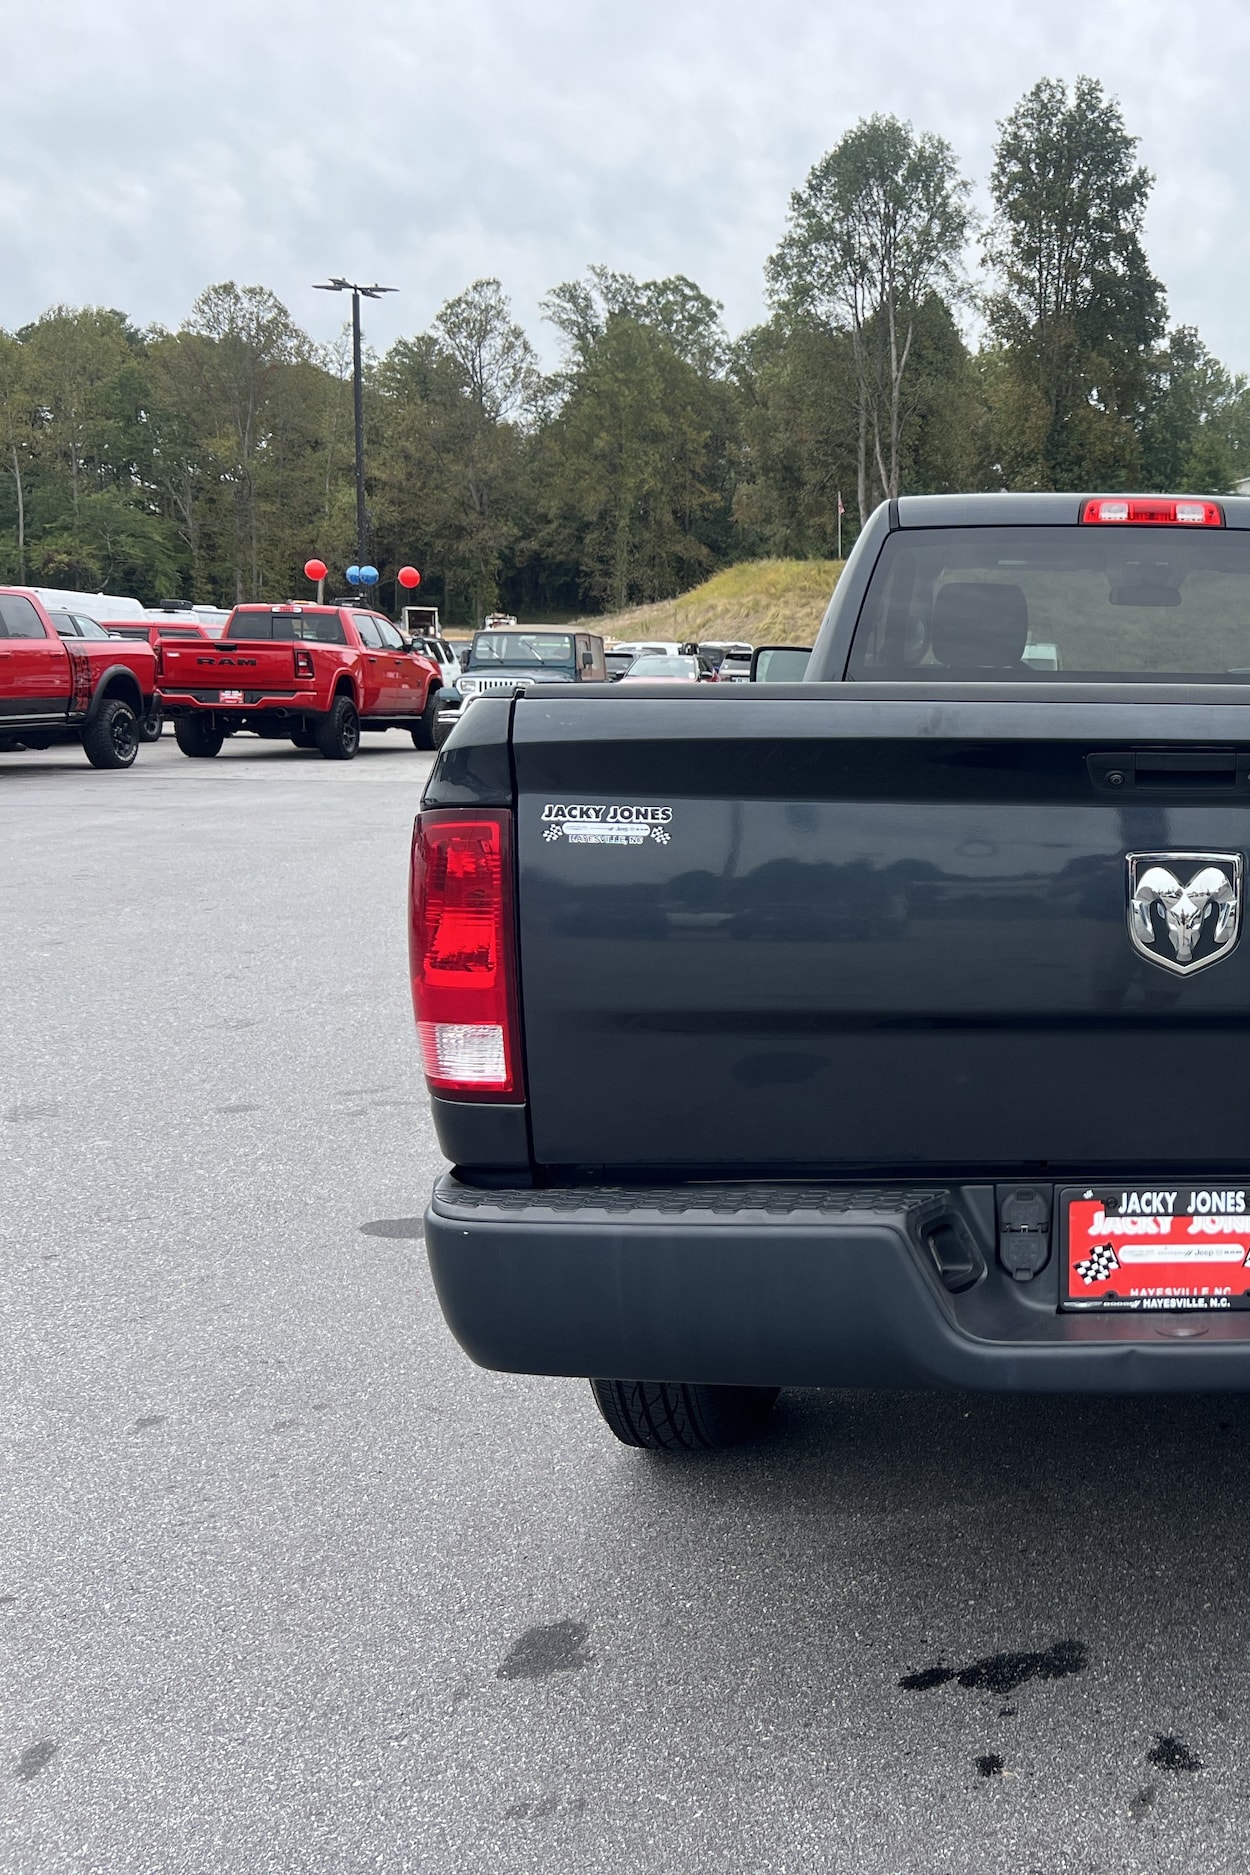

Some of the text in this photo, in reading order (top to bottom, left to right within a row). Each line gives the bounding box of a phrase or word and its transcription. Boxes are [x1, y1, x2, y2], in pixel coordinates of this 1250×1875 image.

[197, 658, 257, 666] RAM
[541, 804, 672, 823] JACKY JONES
[1118, 1191, 1246, 1214] JACKY JONES
[1209, 1297, 1231, 1308] N.C.
